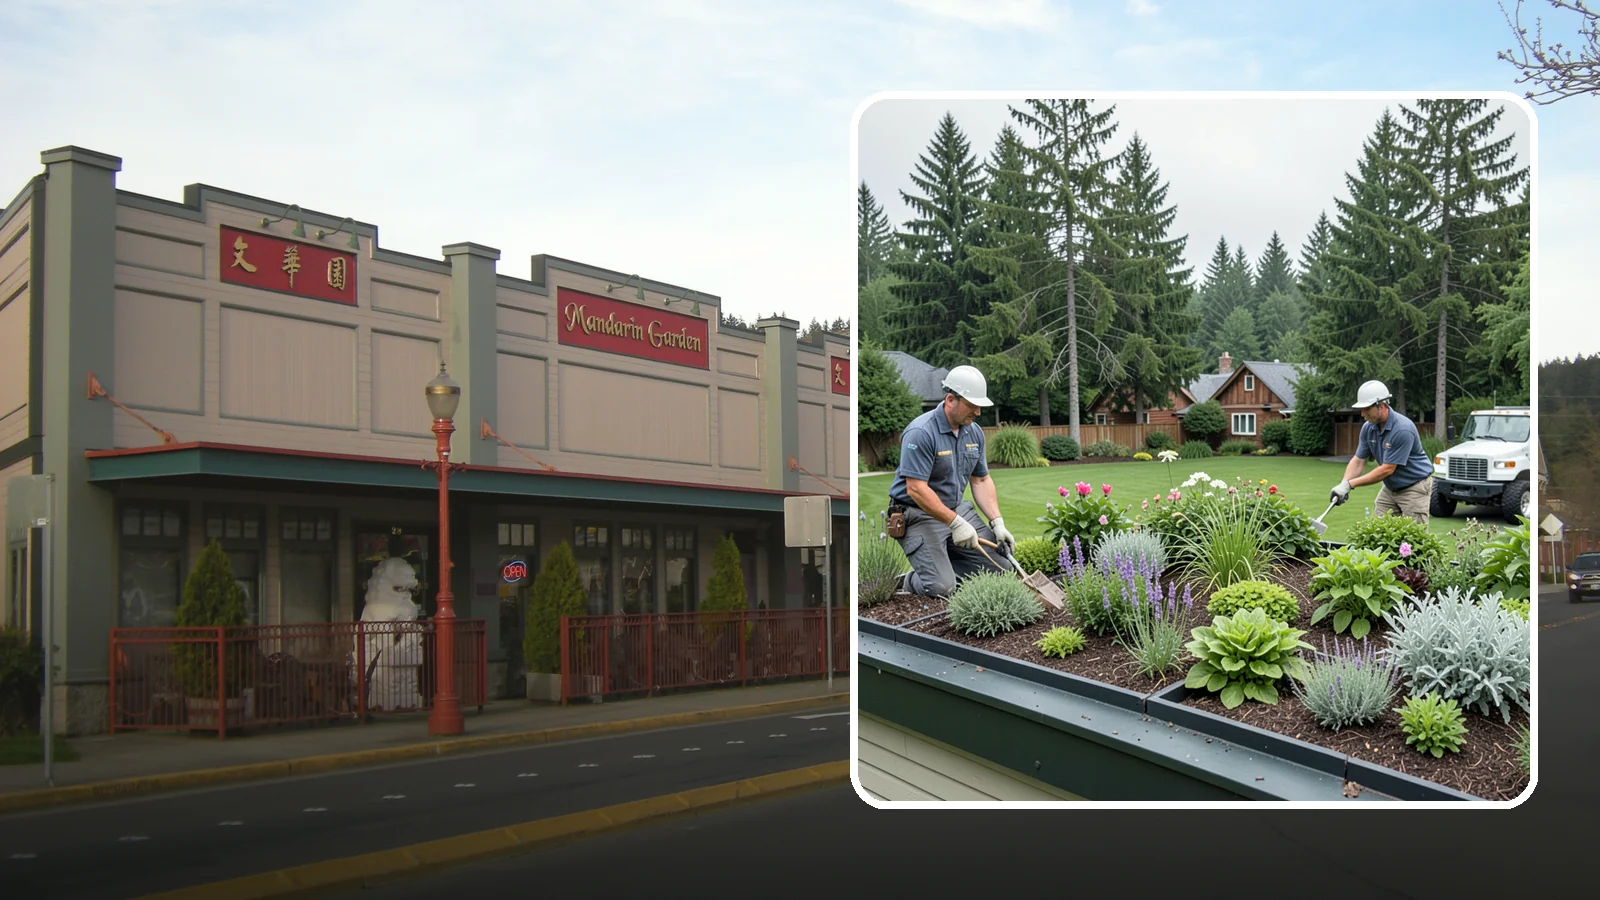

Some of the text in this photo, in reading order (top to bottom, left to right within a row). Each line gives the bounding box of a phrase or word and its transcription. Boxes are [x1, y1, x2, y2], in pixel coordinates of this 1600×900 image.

[231, 235, 346, 291] 文華園
[564, 302, 702, 352] Mandarin Garden
[503, 565, 527, 578] OPEN
